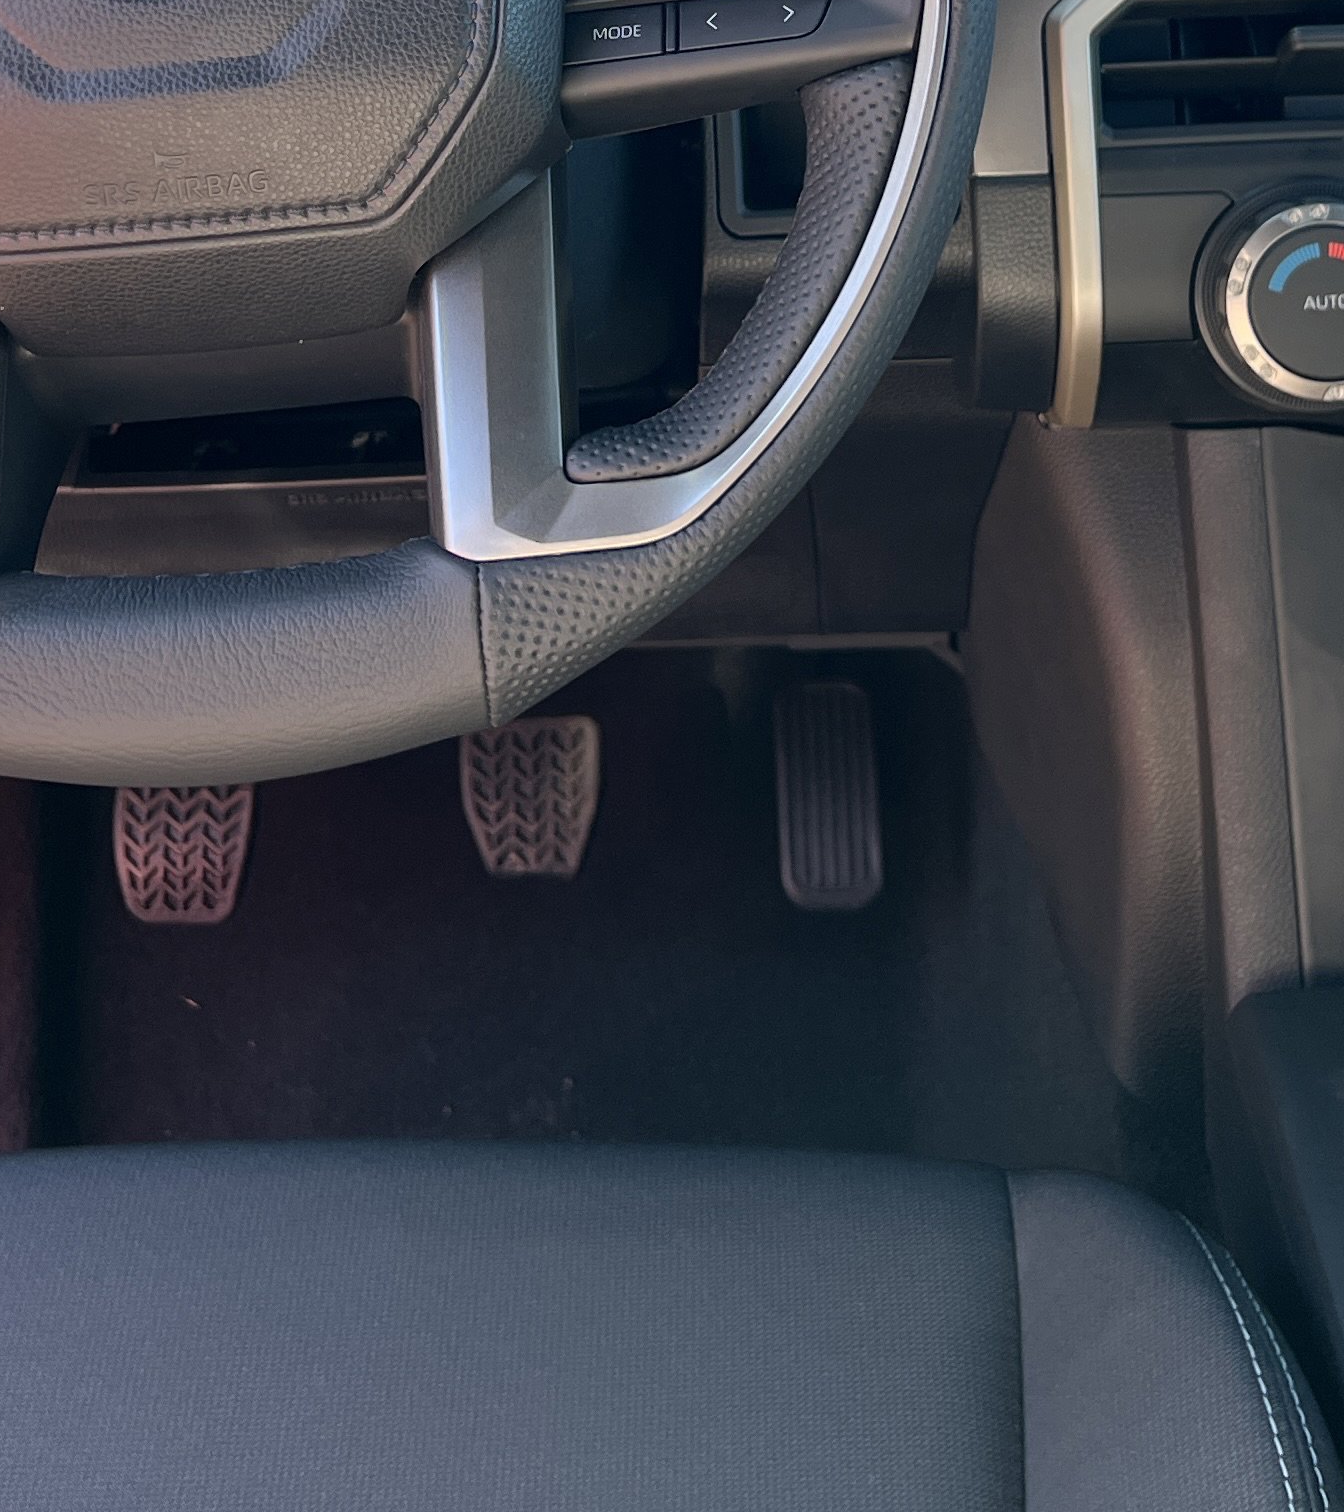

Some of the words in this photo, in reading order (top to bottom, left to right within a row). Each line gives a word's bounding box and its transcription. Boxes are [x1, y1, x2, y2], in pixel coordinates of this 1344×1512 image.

[593, 24, 642, 41] MODE
[83, 181, 140, 205] SRS
[152, 168, 269, 202] AIRBAG
